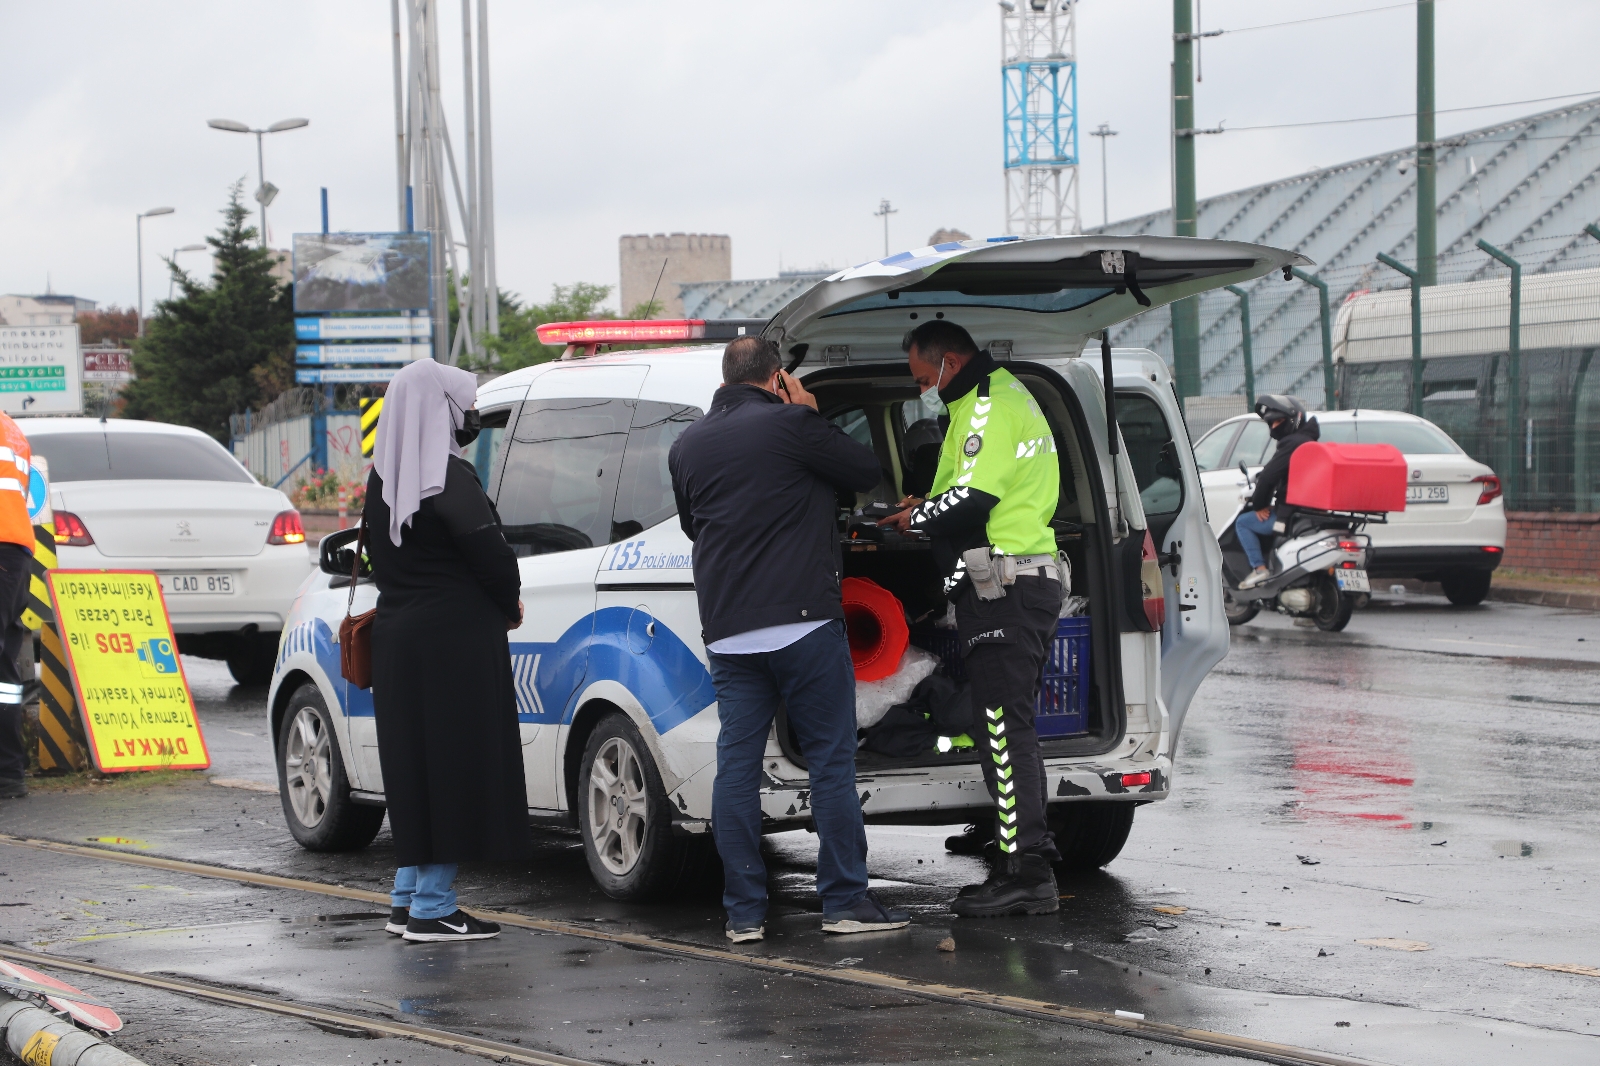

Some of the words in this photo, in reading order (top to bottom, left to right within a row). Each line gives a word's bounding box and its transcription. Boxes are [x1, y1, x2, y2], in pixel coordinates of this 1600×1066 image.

[2, 329, 62, 338] rnekapı
[2, 341, 63, 350] tinburnu
[0, 367, 62, 377] vreyolu
[1, 383, 26, 391] asya
[608, 540, 646, 570] 155
[641, 552, 666, 568] POLİS
[1016, 558, 1032, 566] LIS
[60, 582, 154, 600] Kesilmektedir
[173, 576, 198, 591] CAD
[207, 576, 230, 591] 815
[75, 608, 119, 626] Cezası
[123, 609, 154, 627] Para
[70, 632, 90, 650] ile
[95, 632, 135, 654] EDS
[86, 687, 139, 705] Yasaktır
[139, 686, 187, 704] Girmek
[94, 711, 139, 730] Yoluna
[140, 707, 193, 728] Tramvay
